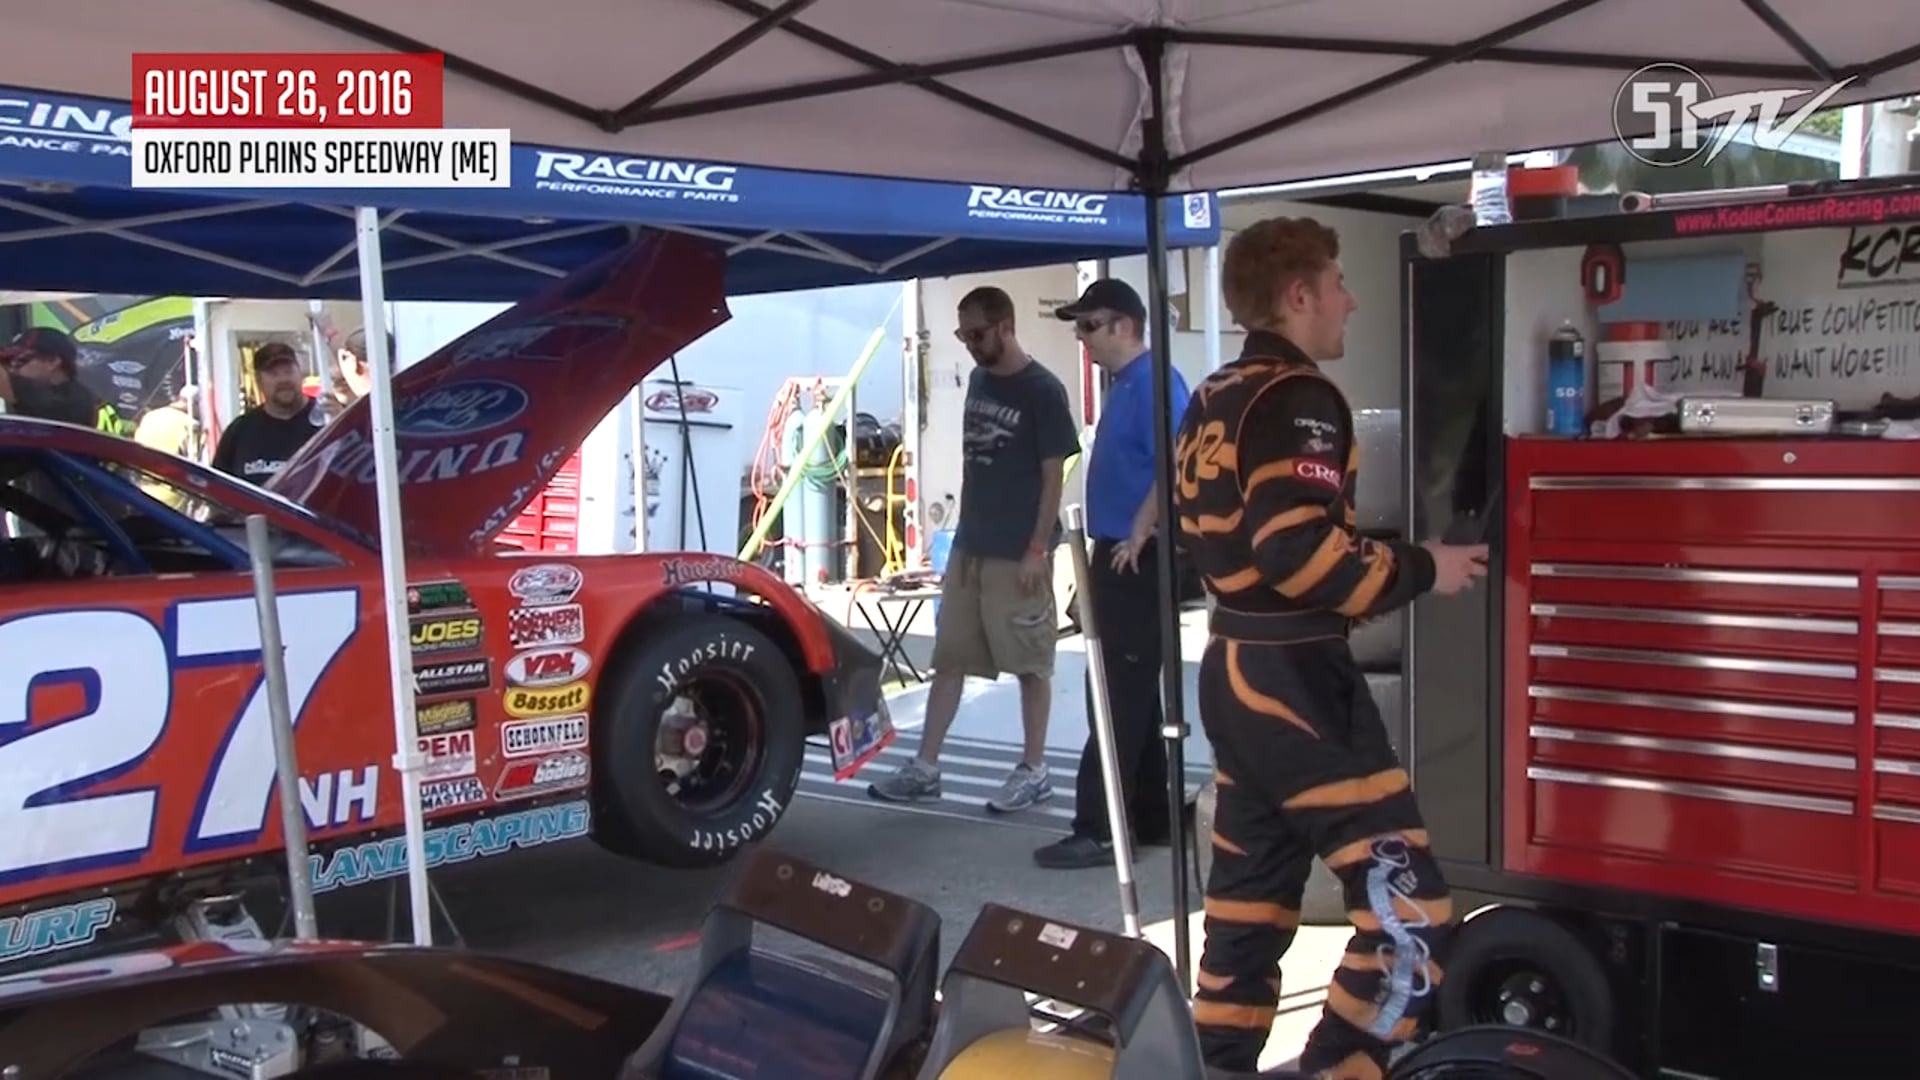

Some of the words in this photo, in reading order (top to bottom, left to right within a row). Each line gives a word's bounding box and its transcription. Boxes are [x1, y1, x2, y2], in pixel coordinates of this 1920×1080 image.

[535, 151, 737, 191] RACING
[536, 181, 676, 198] PERFORMANCE
[683, 191, 739, 203] PARTS
[968, 185, 1108, 215] RACING
[969, 210, 1063, 222] PERFORMANCE
[1068, 216, 1107, 225] PARTS
[1775, 346, 1826, 379] WANT
[661, 556, 745, 587] Hoosier
[412, 619, 480, 644] JOES
[418, 662, 485, 680] ALLSTAR
[657, 633, 755, 693] Hoosier
[512, 687, 583, 711] Bassett
[0, 585, 360, 884] 27
[508, 721, 584, 748] SCHOENFELD
[299, 765, 379, 829] NH
[419, 779, 478, 798] UARTER
[421, 790, 484, 812] MASTER
[690, 788, 783, 857] Hoosier
